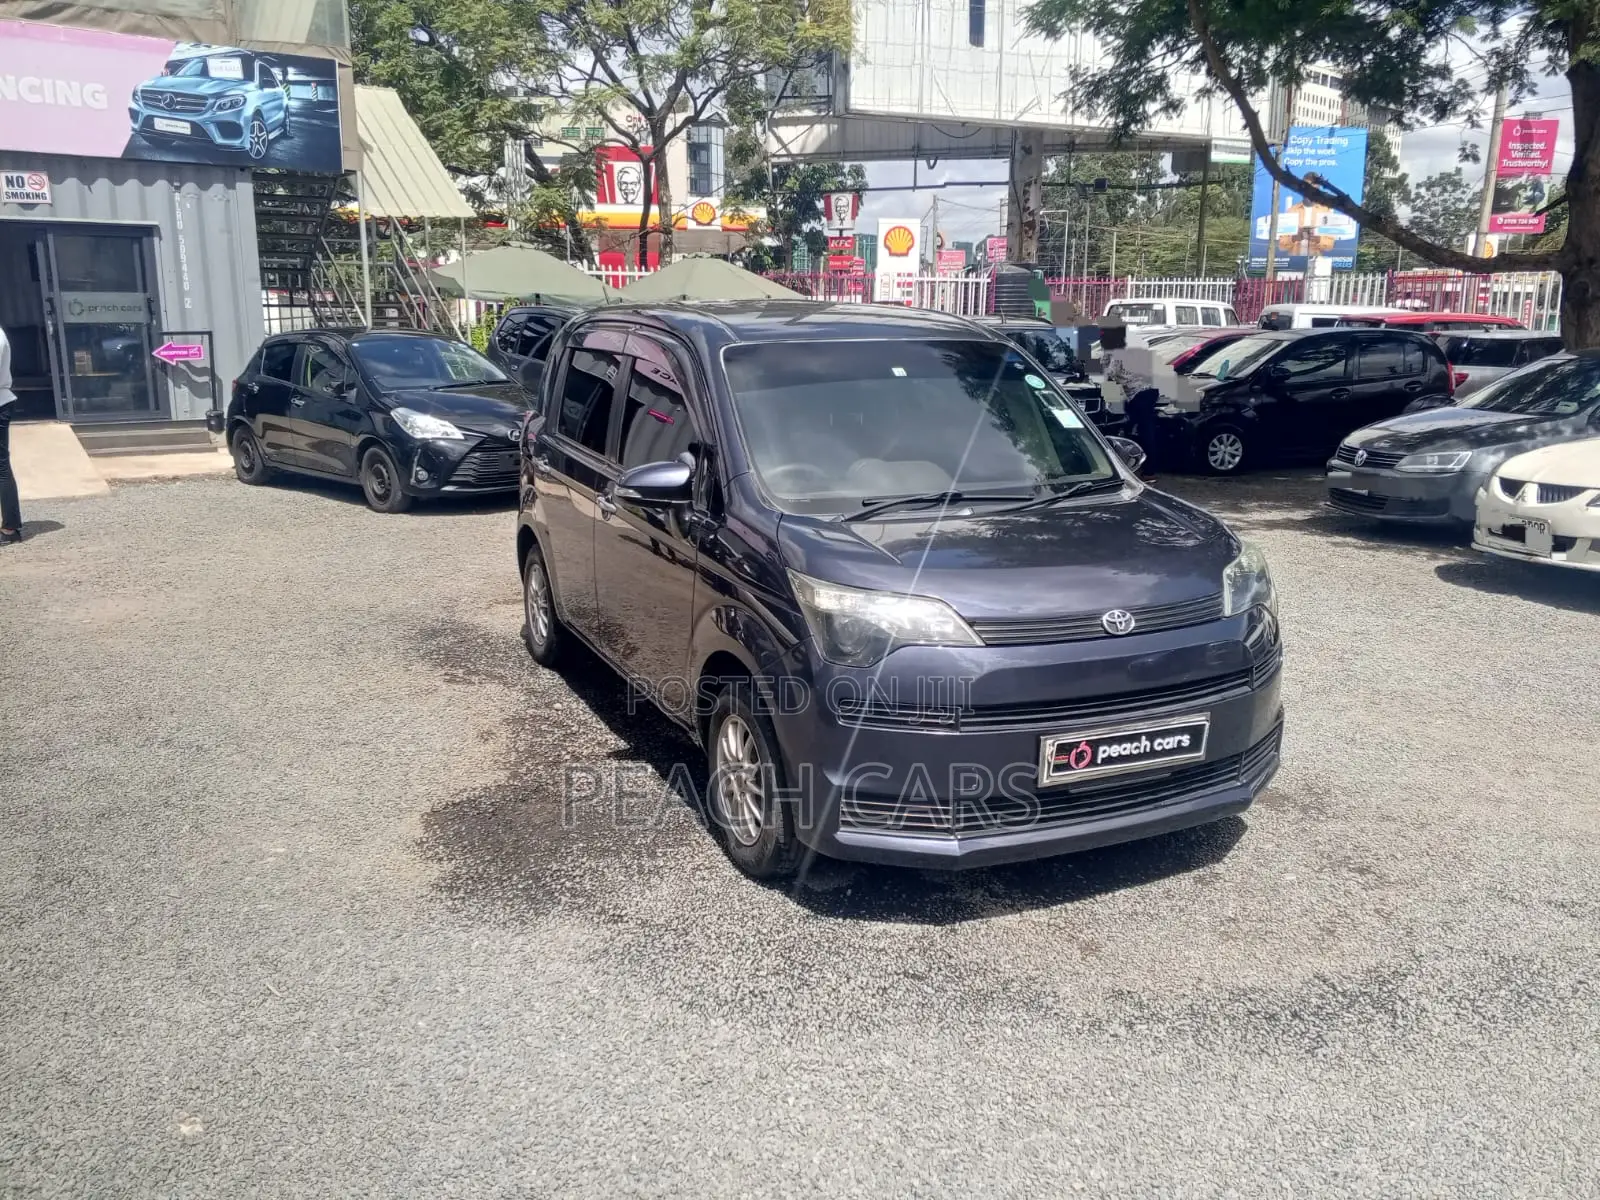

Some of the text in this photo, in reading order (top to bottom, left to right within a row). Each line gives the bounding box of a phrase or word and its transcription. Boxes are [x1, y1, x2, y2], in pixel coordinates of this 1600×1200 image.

[1290, 136, 1349, 147] Copy Trading
[1508, 141, 1547, 151] Inspected.
[1511, 150, 1542, 158] Verified.
[1284, 157, 1304, 167] Copy
[1305, 158, 1319, 166] the
[1502, 159, 1549, 169] Trustworthy!
[4, 175, 26, 189] NO
[4, 191, 48, 201] SMOKING
[830, 239, 852, 248] KFC
[1097, 733, 1191, 764] peach cars
